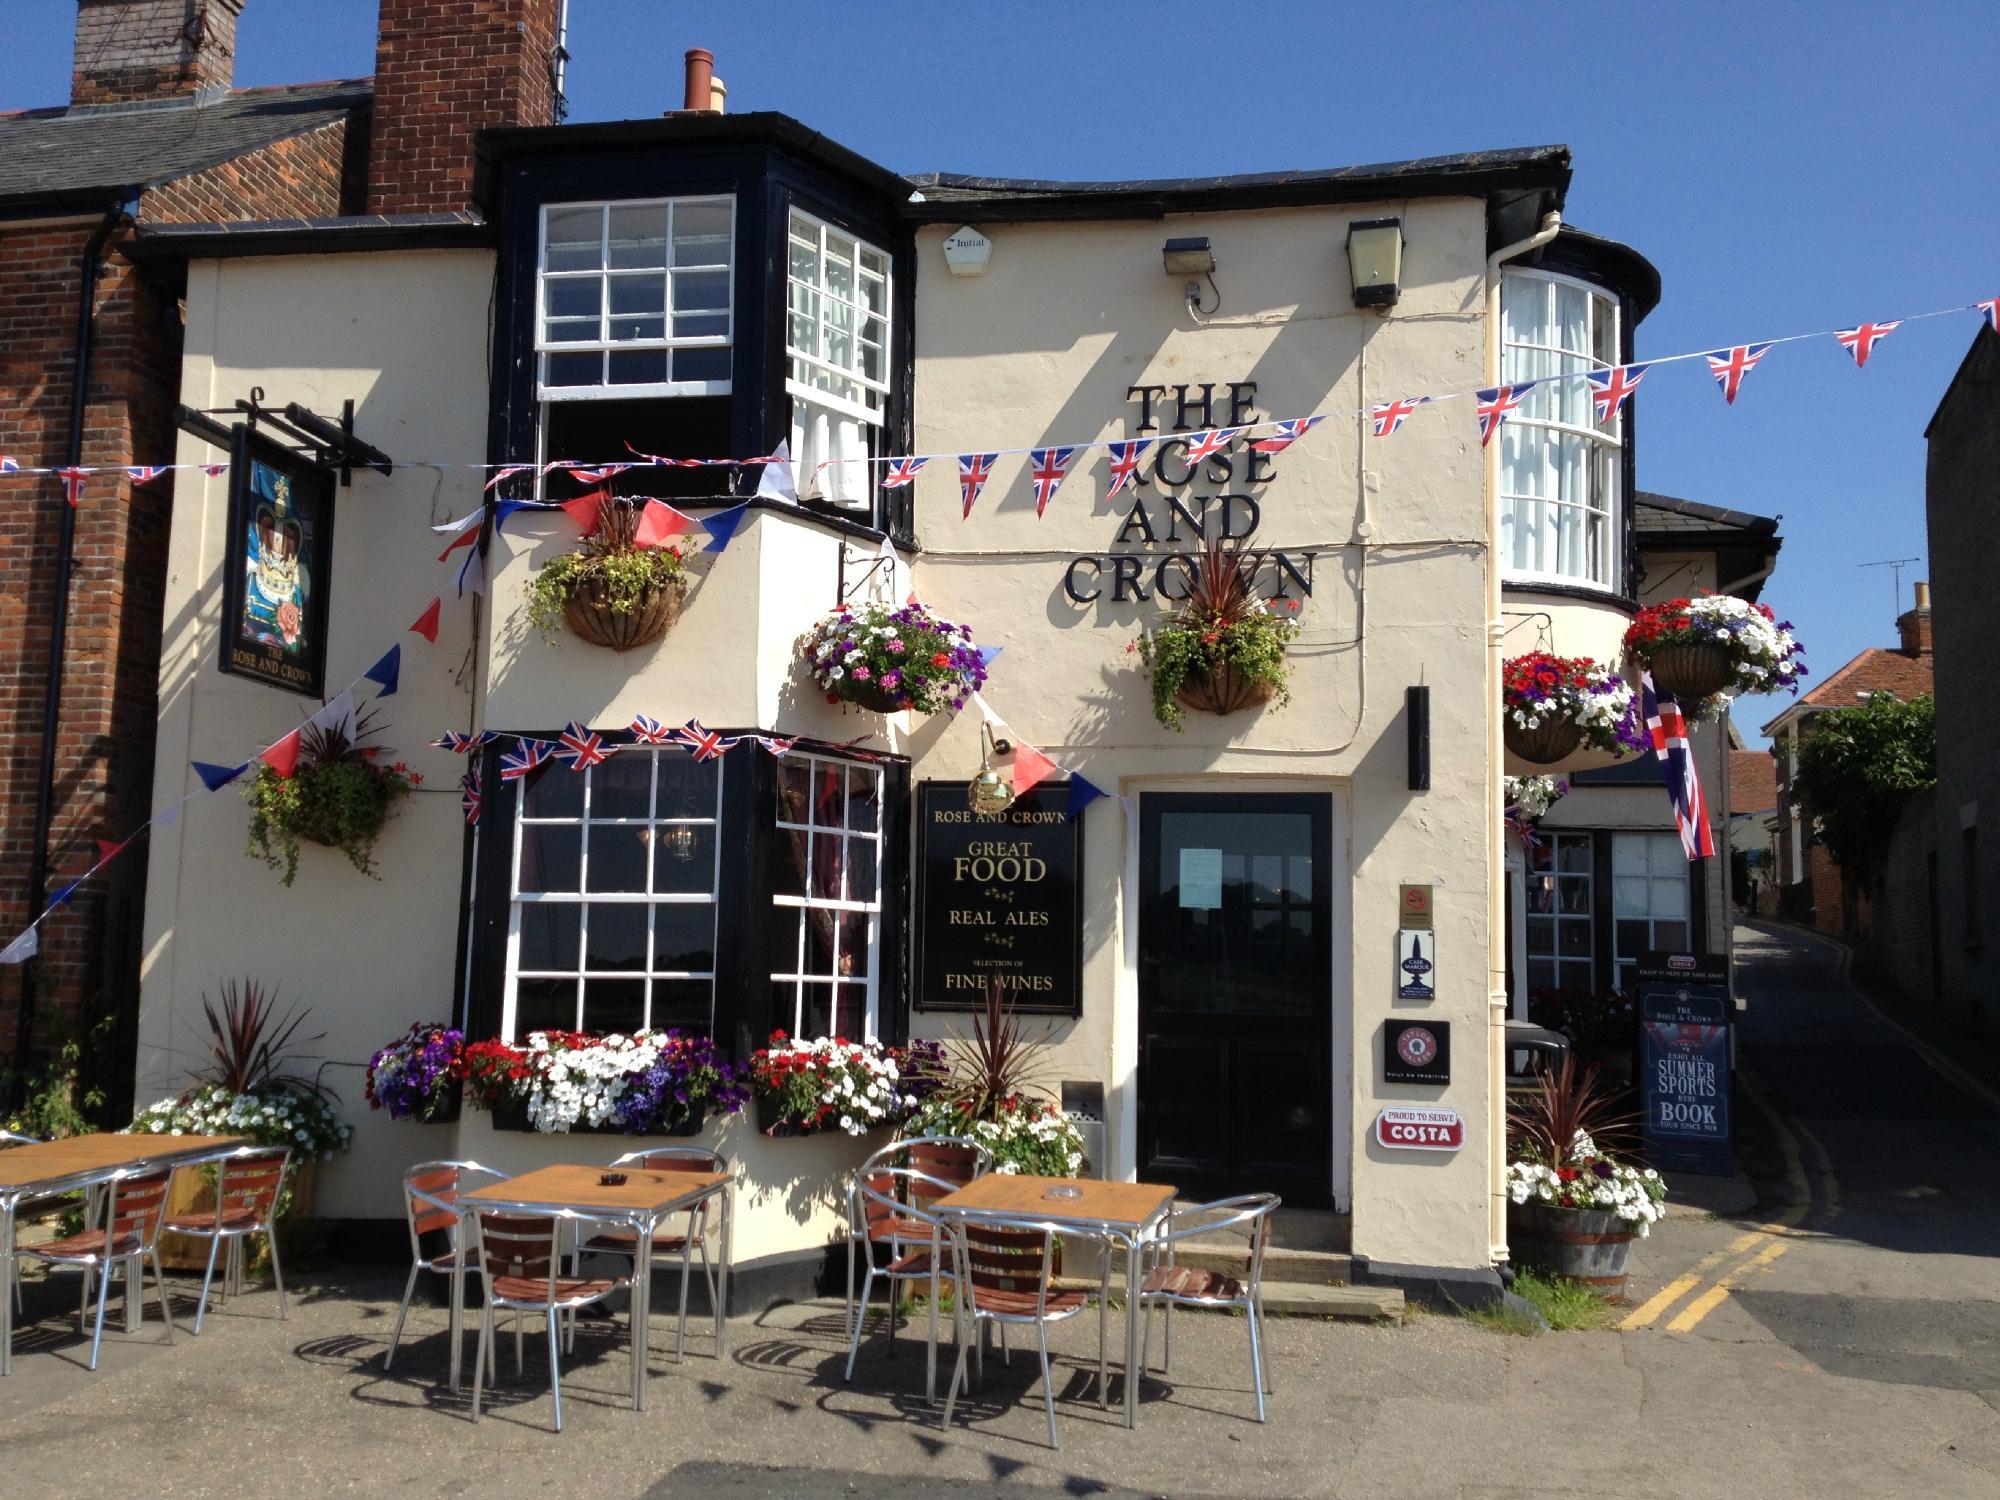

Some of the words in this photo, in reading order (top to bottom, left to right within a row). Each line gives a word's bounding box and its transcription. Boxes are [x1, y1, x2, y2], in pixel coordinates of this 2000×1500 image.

[957, 237, 984, 247] Initial
[1126, 381, 1259, 431] THE
[1111, 438, 1277, 486] OSE
[1117, 494, 1260, 542] AND
[266, 646, 283, 661] THE
[232, 647, 257, 668] ROSE
[258, 657, 279, 674] AND
[281, 664, 313, 684] CROWN
[934, 810, 971, 823] ROSE
[975, 812, 1007, 823] AND
[1012, 811, 1067, 825] CROWN
[968, 840, 1033, 857] GREAT
[953, 857, 1047, 882] FOOD
[949, 910, 997, 925] REAL
[1005, 911, 1049, 926] ALES
[945, 974, 986, 989] FINE
[993, 975, 1053, 990] WINES
[1687, 1014, 1712, 1023] CROWN
[1402, 1030, 1431, 1043] TAYLOR
[1402, 1048, 1432, 1063] WALKER
[1668, 1053, 1688, 1061] ENJOY
[1658, 1059, 1715, 1079] SUMMER
[1658, 1075, 1716, 1097] SPORTS
[1388, 1111, 1415, 1121] PROUD
[1417, 1112, 1427, 1121] TO
[1428, 1113, 1454, 1122] SERVE
[1660, 1101, 1717, 1124] BOOK
[1391, 1125, 1452, 1143] COSTA
